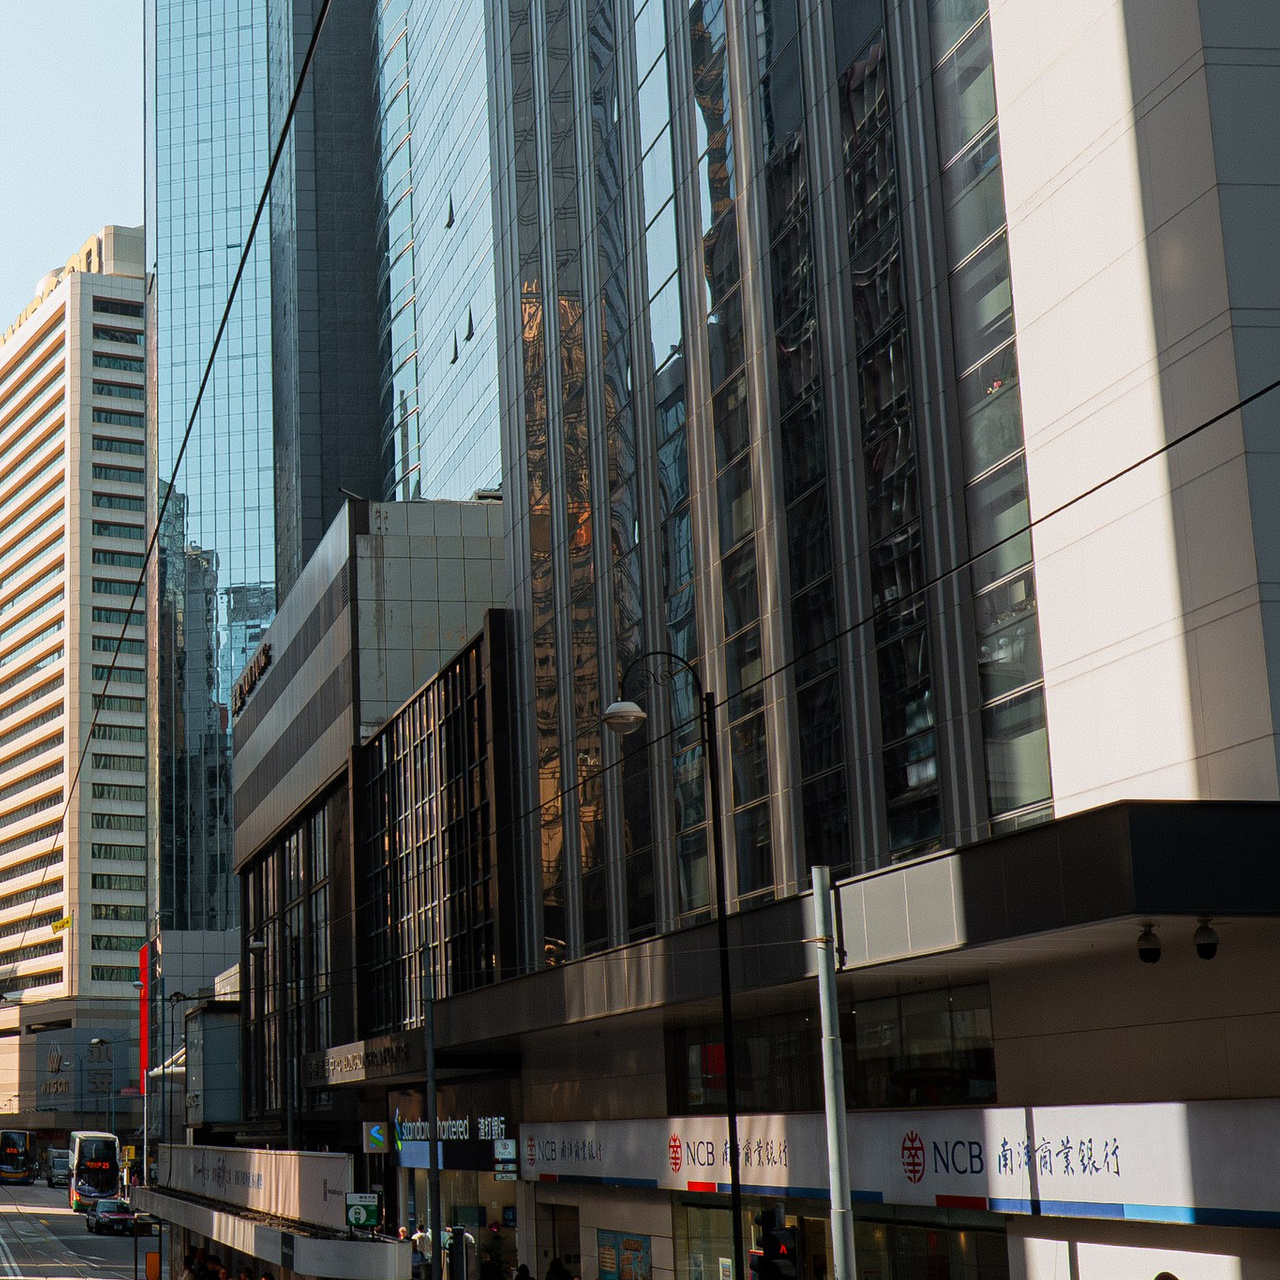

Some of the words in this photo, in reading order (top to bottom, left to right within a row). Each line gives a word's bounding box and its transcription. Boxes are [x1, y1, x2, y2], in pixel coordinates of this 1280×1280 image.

[538, 1140, 557, 1161] NCB
[686, 1140, 715, 1167] NCB
[932, 1140, 984, 1175] NCB
